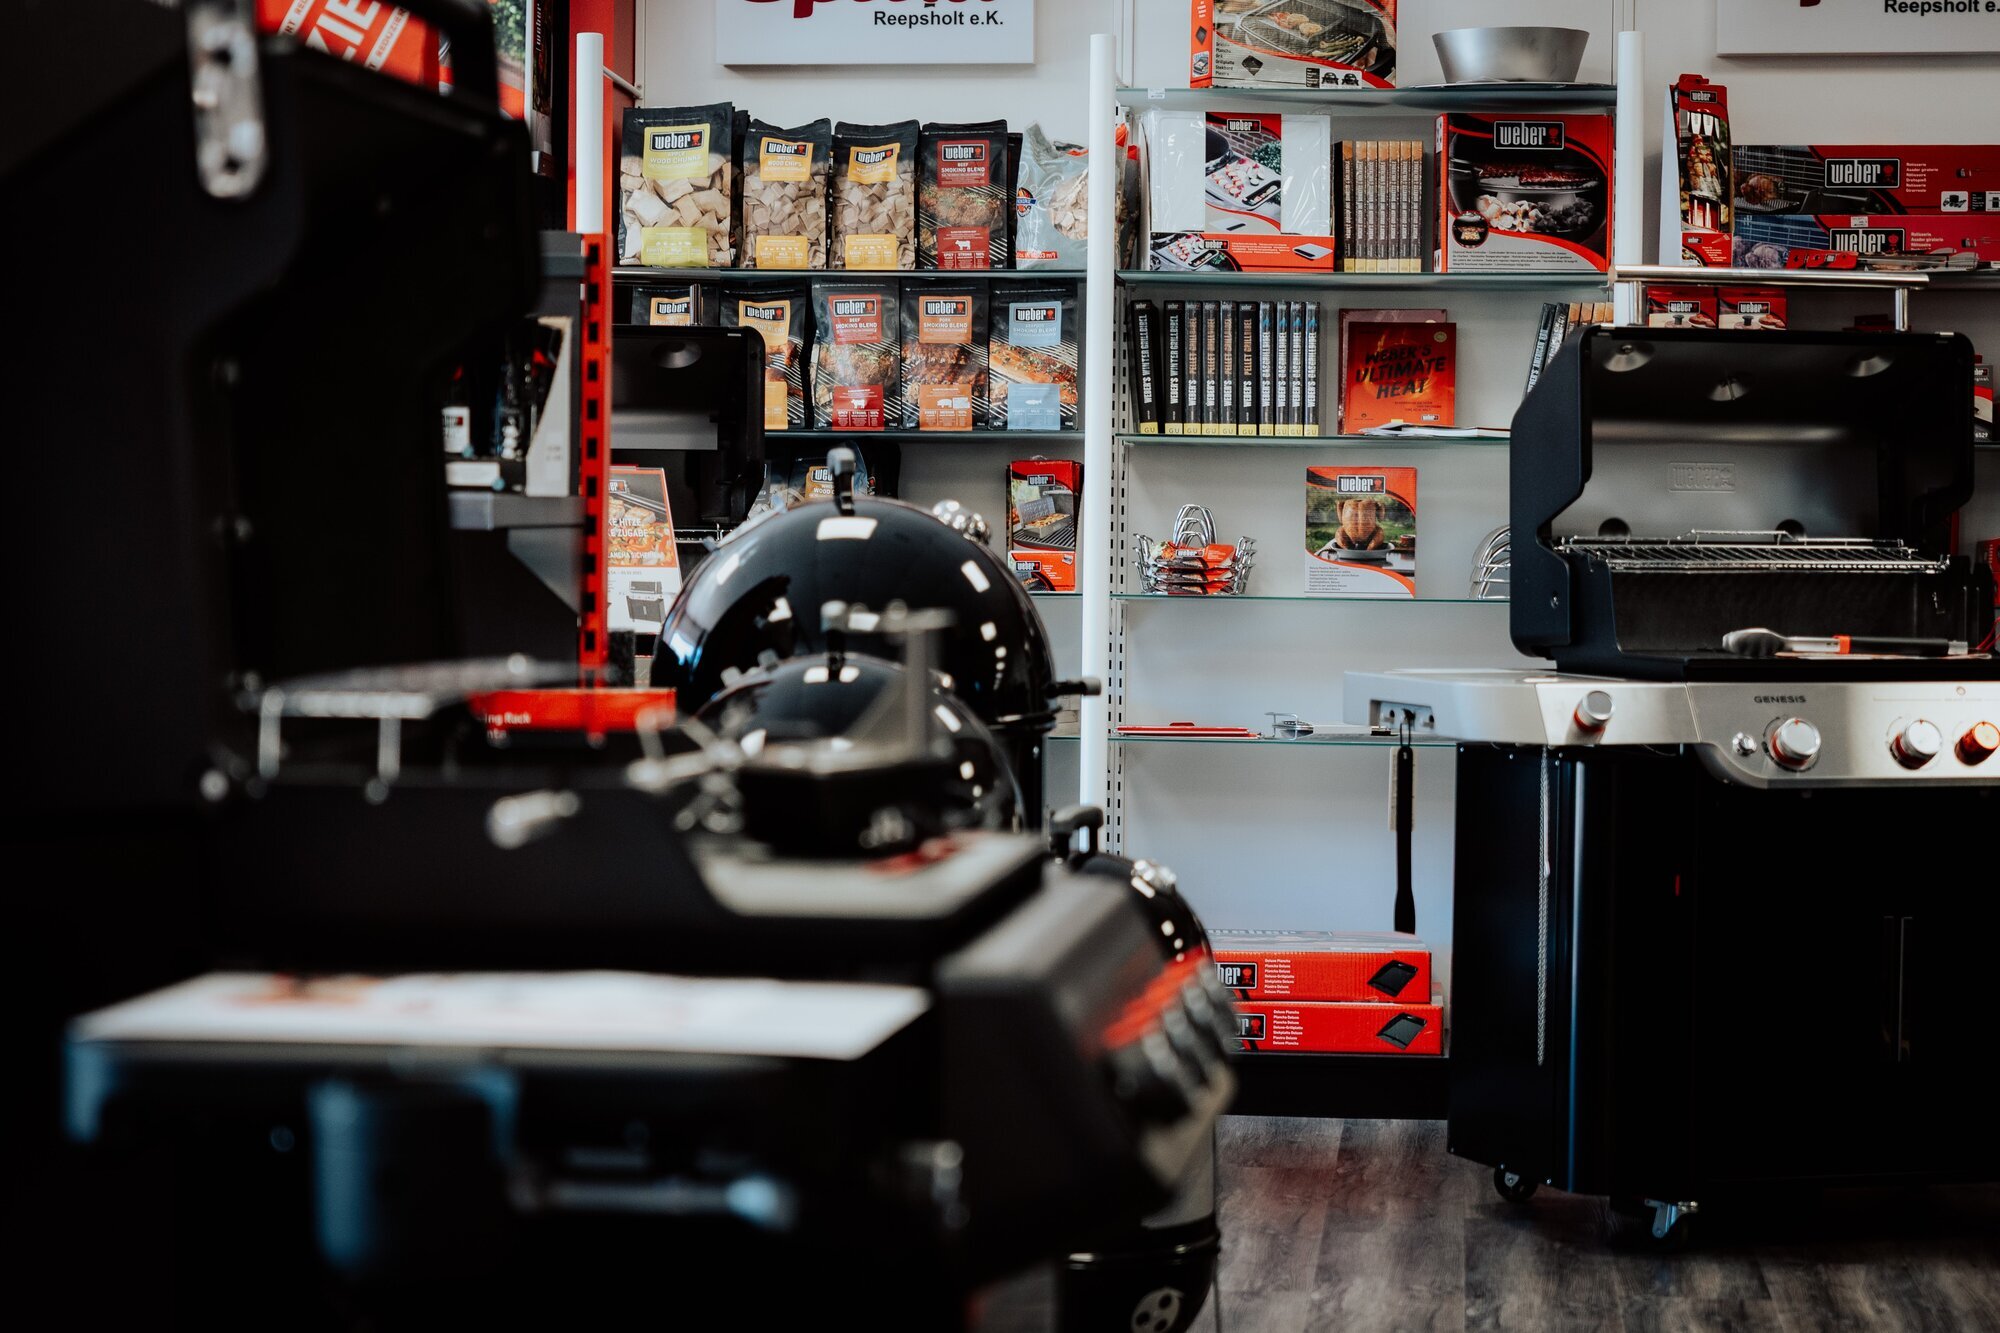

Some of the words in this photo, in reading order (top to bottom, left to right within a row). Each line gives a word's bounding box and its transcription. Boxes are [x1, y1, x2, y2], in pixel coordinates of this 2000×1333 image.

[1884, 0, 1980, 16] Reepsholt
[874, 10, 964, 29] Reepsholt
[969, 11, 1004, 26] e.K.
[1691, 91, 1711, 101] weber
[1229, 119, 1253, 131] weber
[654, 132, 691, 150] weber
[1499, 122, 1547, 147] weber
[768, 142, 798, 154] weber
[858, 150, 885, 163] weber
[945, 145, 974, 159] weber
[1831, 158, 1881, 184] weber
[1204, 240, 1223, 249] weber
[1836, 229, 1886, 252] weber
[659, 301, 688, 314] weber
[747, 306, 776, 320] weber
[836, 300, 866, 315] weber
[927, 300, 957, 315] weber
[1017, 308, 1047, 321] weber
[1670, 301, 1693, 312] weber
[1740, 301, 1762, 313] weber
[1365, 344, 1433, 365] WEBER'S
[1188, 353, 1197, 375] PELLET
[1207, 353, 1215, 375] PELLET
[1243, 353, 1252, 376] PELLET
[1356, 356, 1447, 382] ULTIMATE
[1142, 376, 1153, 404] WEBER'S
[1170, 377, 1179, 404] WEBER'S
[1188, 379, 1197, 406] WEBER'S
[1206, 380, 1215, 407] WEBER'S
[1223, 380, 1232, 407] WEBER'S
[1243, 380, 1252, 408] WEBER'S
[1262, 380, 1270, 407] WEBER'S
[1278, 380, 1286, 407] WEBER'S
[1292, 380, 1301, 408] WEBER'S
[1307, 380, 1316, 408] WEBER'S
[1376, 377, 1429, 399] HEAT
[1029, 475, 1049, 485] weber
[1340, 476, 1373, 492] weber
[814, 487, 831, 495] WOOD
[1016, 561, 1035, 571] weber
[1753, 694, 1807, 704] GENESIS
[504, 711, 532, 725] Rack
[1216, 963, 1241, 985] ber
